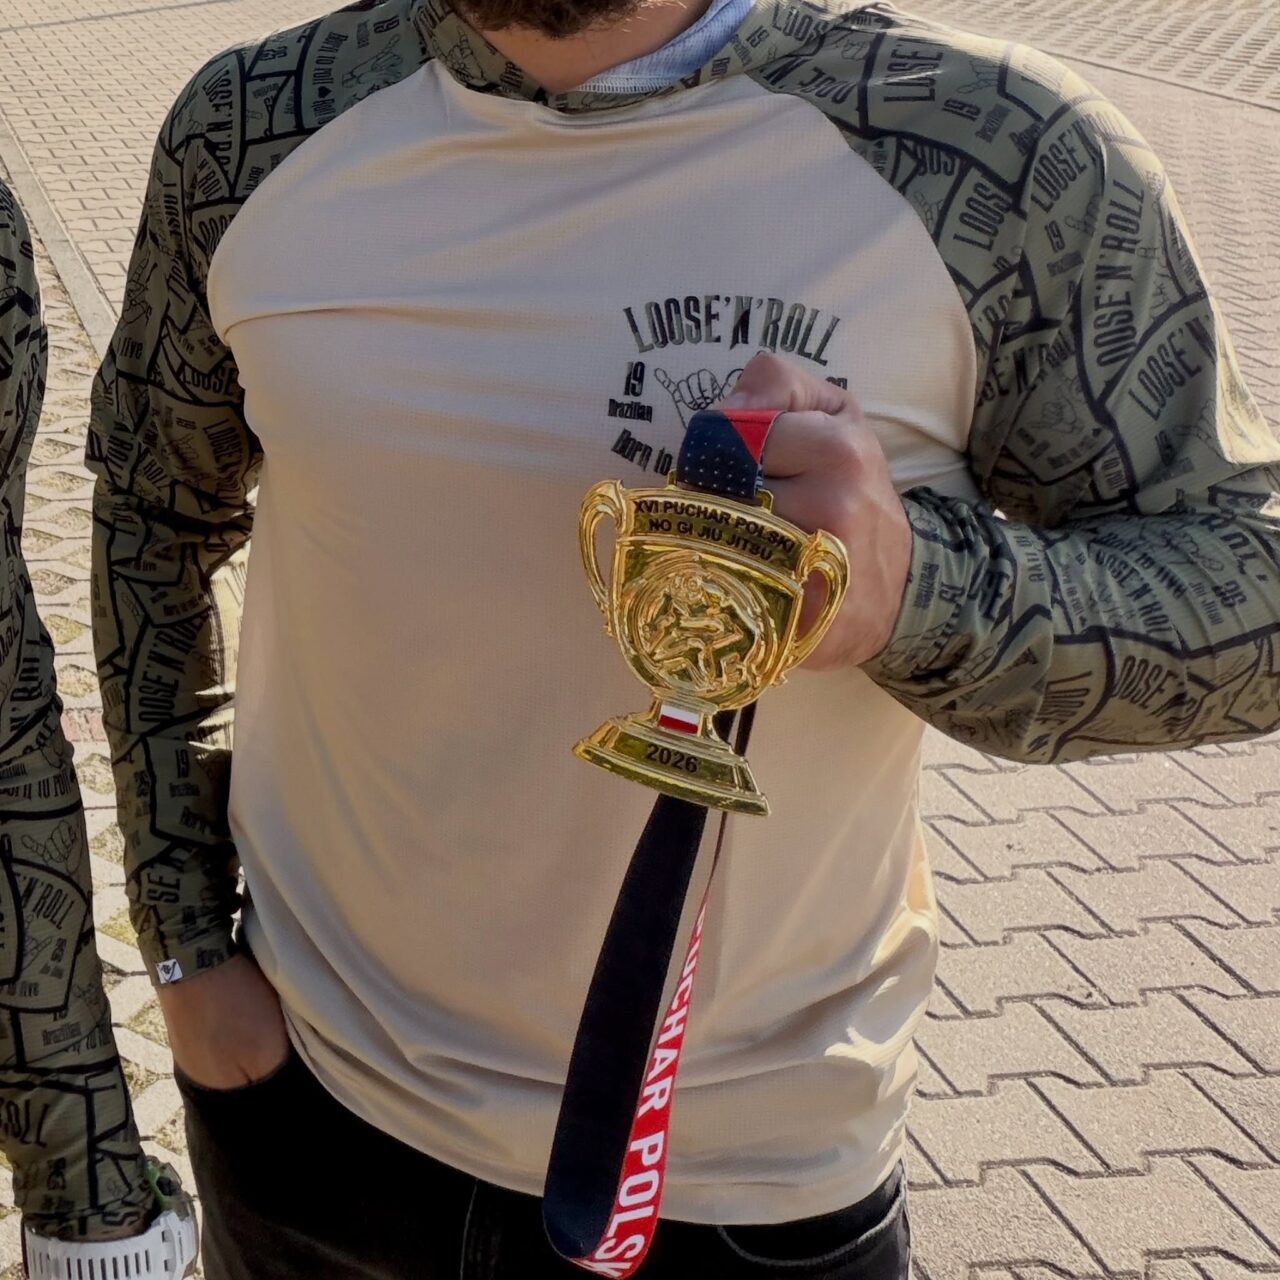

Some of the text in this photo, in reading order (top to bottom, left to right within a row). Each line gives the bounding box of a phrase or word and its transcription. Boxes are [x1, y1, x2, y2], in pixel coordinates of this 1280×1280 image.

[623, 294, 841, 366] LOOSE'N'ROLL
[624, 361, 645, 397] 19
[608, 398, 653, 423] Brazilian
[610, 428, 673, 477] Born to
[634, 500, 795, 553] XVI PUCHAR POLSKI
[649, 518, 772, 561] NO GI JIU JITSU
[646, 743, 699, 773] 2026
[586, 1130, 665, 1277] POLSK
